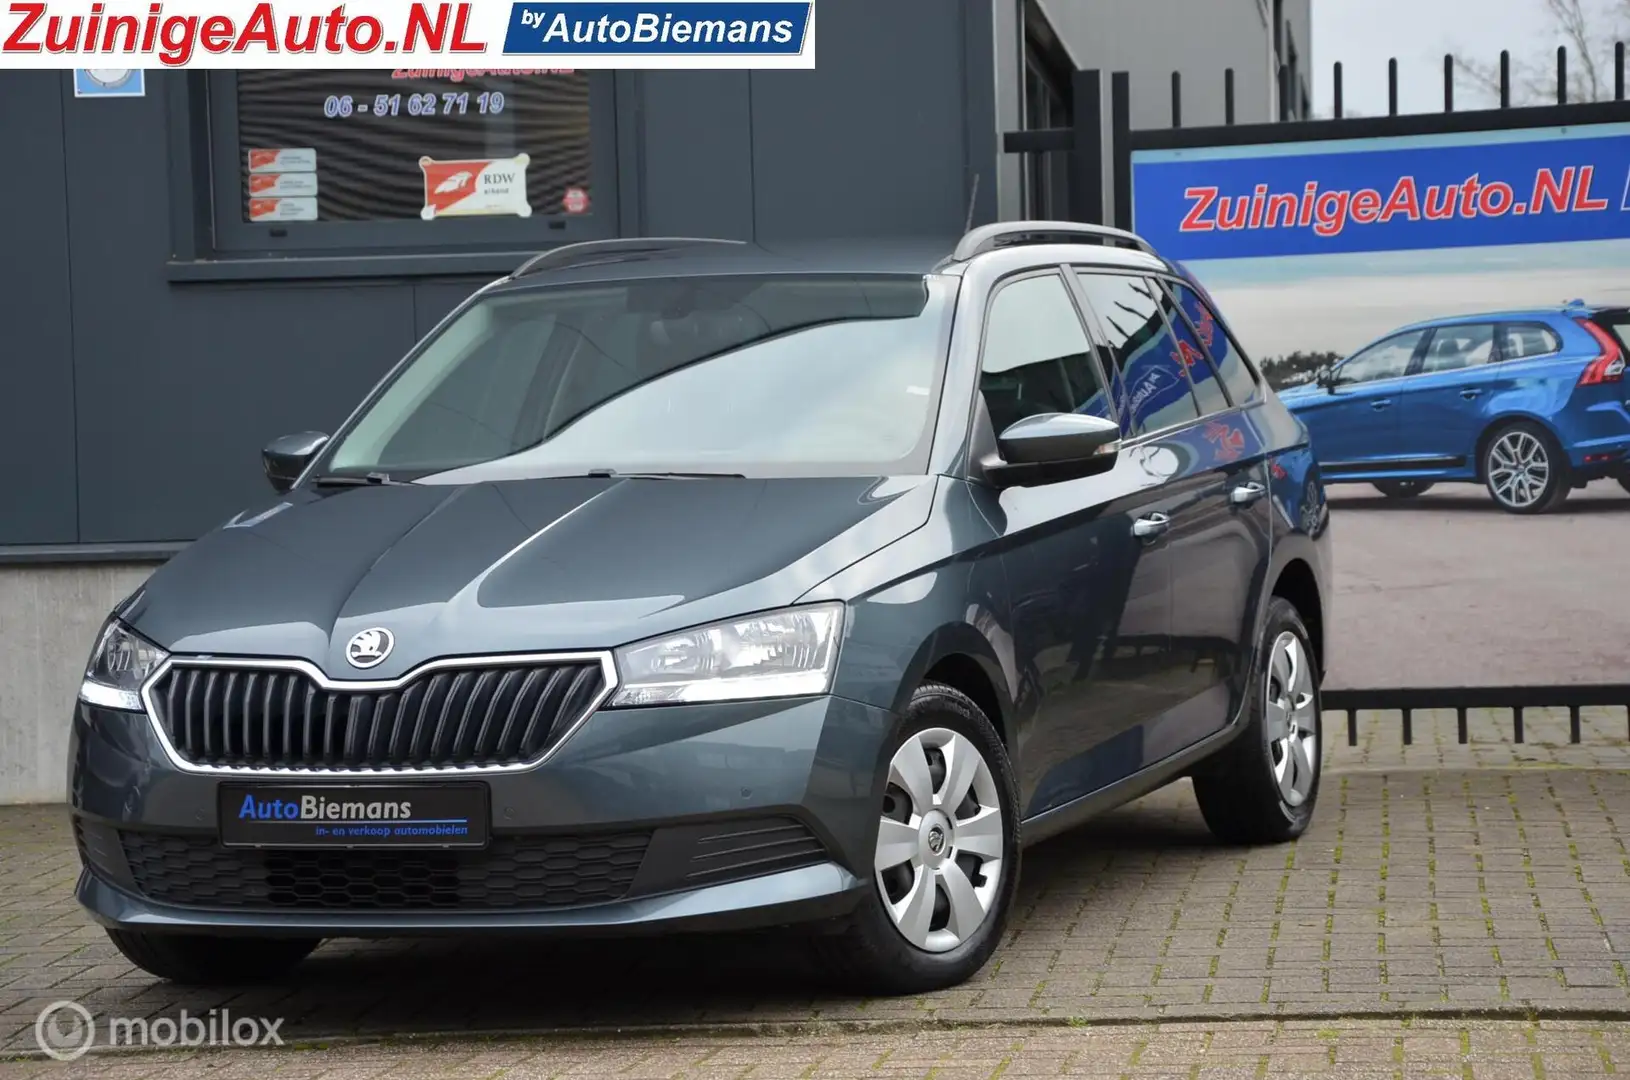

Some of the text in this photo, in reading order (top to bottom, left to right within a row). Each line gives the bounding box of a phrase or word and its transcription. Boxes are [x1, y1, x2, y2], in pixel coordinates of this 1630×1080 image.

[323, 95, 353, 118] 06
[373, 94, 401, 116] 51
[408, 93, 436, 116] 62
[442, 92, 469, 115] 71
[476, 91, 505, 114] 19
[484, 172, 516, 185] RDW
[1179, 165, 1608, 237] ZuinigeAuto.NL
[238, 794, 412, 820] AutoBiemans
[315, 825, 468, 838] in- en verkoop automobielen
